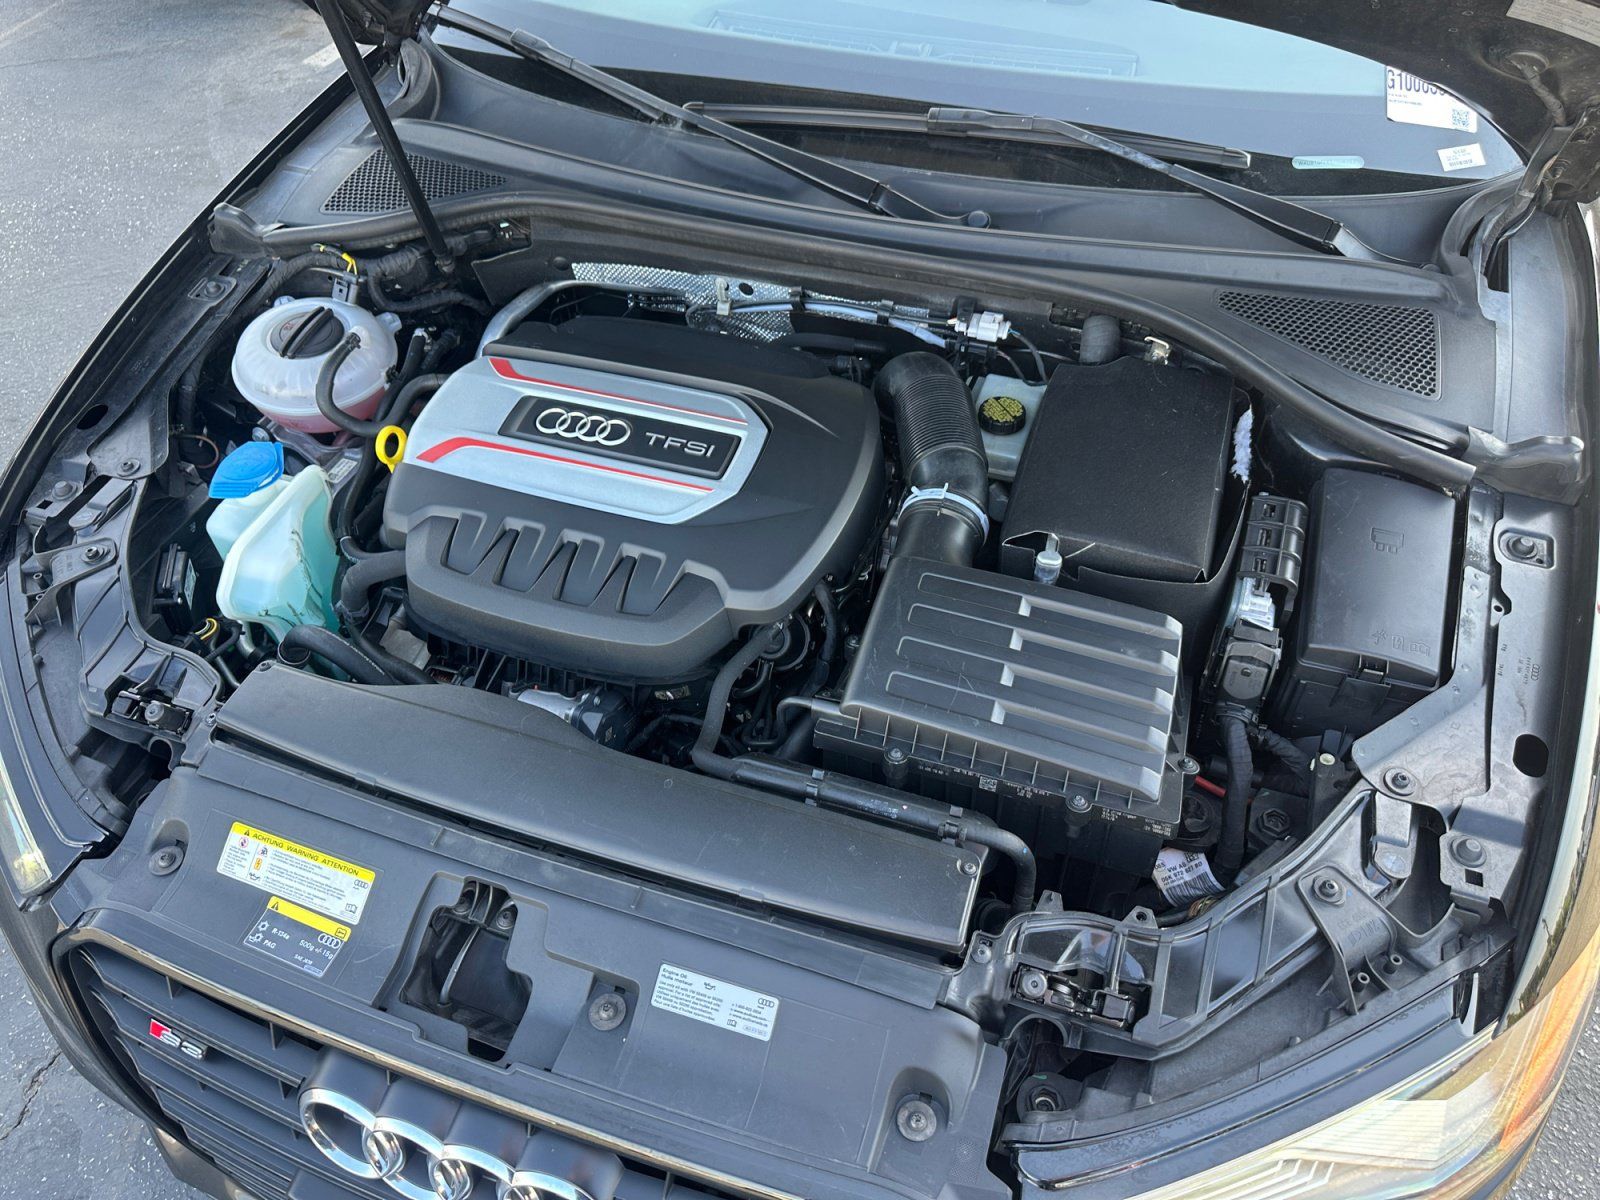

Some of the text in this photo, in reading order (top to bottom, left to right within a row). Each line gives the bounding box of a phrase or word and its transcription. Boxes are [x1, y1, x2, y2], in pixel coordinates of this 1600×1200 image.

[1388, 69, 1445, 96] G1000
[646, 432, 715, 458] TFSI
[253, 833, 284, 848] ACHTUNG
[286, 845, 319, 861] WARNING
[322, 858, 359, 876] ATTENTION
[272, 928, 290, 940] R-134a
[263, 940, 276, 949] PAG
[299, 940, 315, 951] 500g
[322, 950, 334, 960] 15g
[663, 968, 679, 976] Engine
[674, 978, 693, 986] moteur
